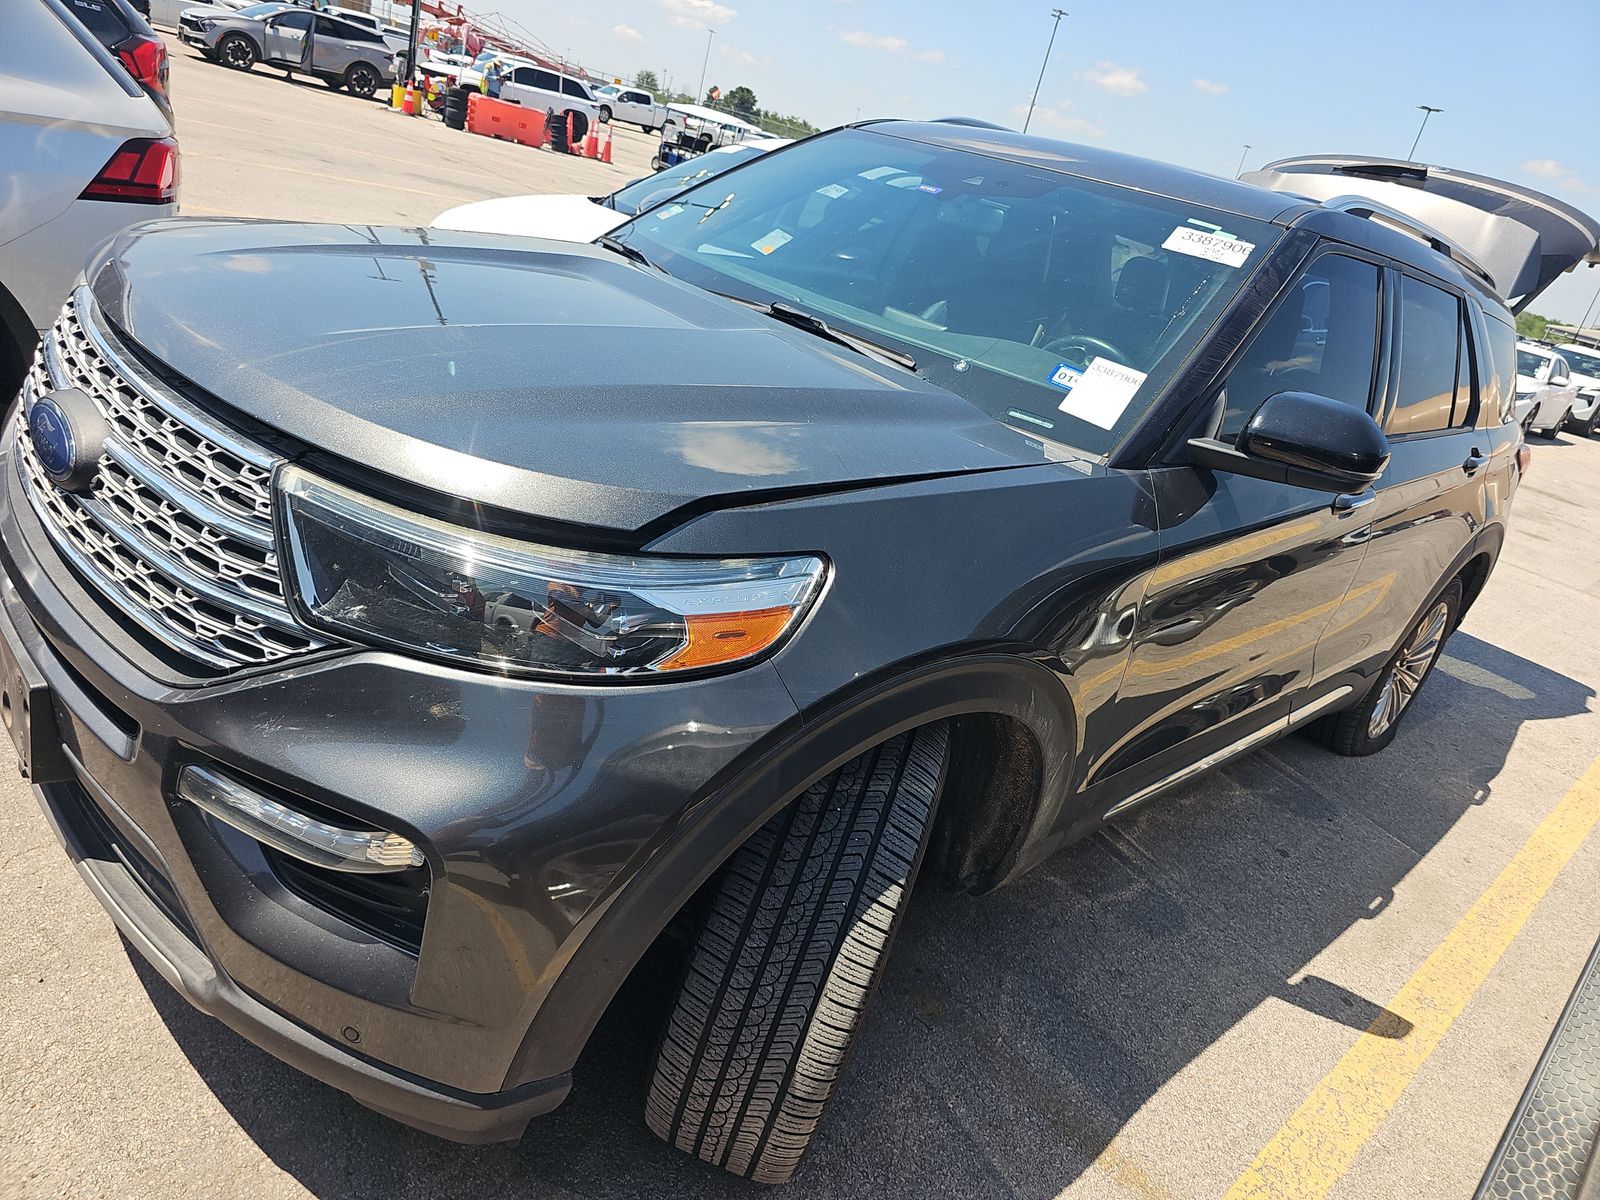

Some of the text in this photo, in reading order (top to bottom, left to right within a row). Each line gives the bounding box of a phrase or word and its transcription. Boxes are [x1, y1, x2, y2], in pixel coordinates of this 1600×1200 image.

[74, 0, 102, 12] SLE
[1181, 231, 1253, 256] 3387906
[1092, 362, 1143, 387] 3387906
[681, 589, 793, 607] EXPLORER
